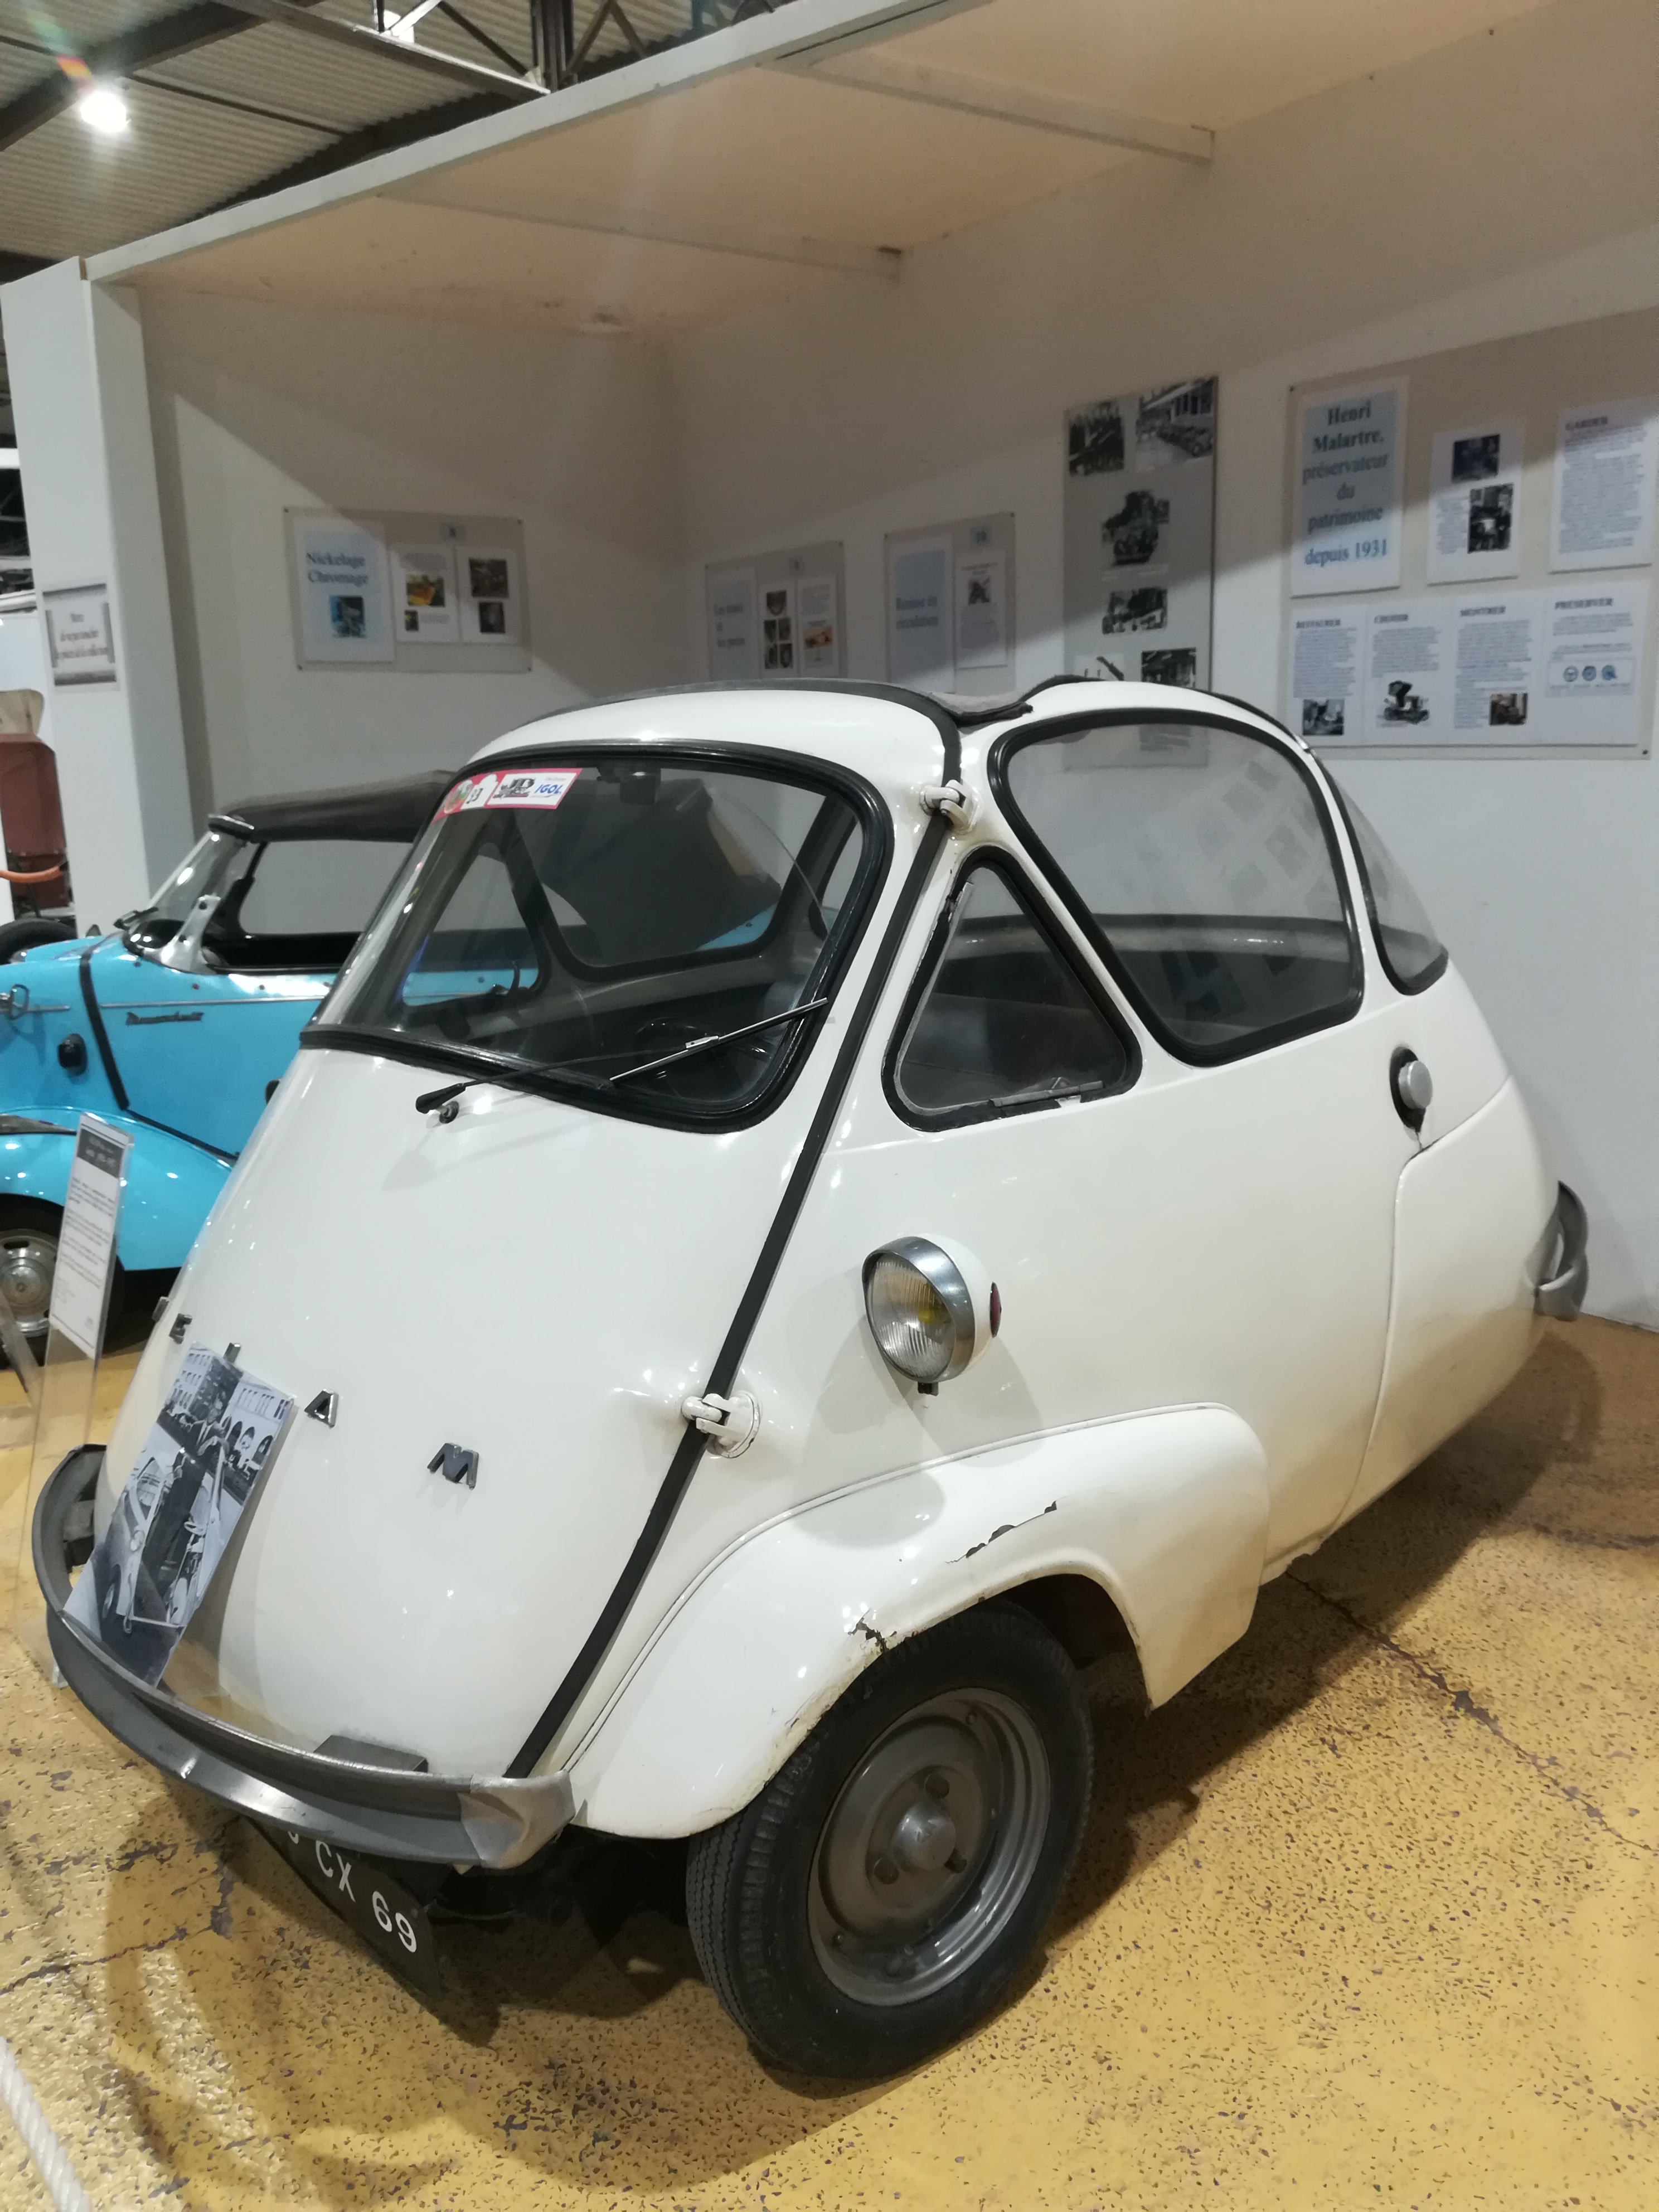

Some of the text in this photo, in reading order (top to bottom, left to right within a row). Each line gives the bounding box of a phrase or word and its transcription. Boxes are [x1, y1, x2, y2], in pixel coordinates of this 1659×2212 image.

[1327, 399, 1371, 425] Henri
[1304, 539, 1387, 567] depuis 1931
[535, 784, 564, 794] IGOL
[316, 1840, 417, 1953] CX 69
